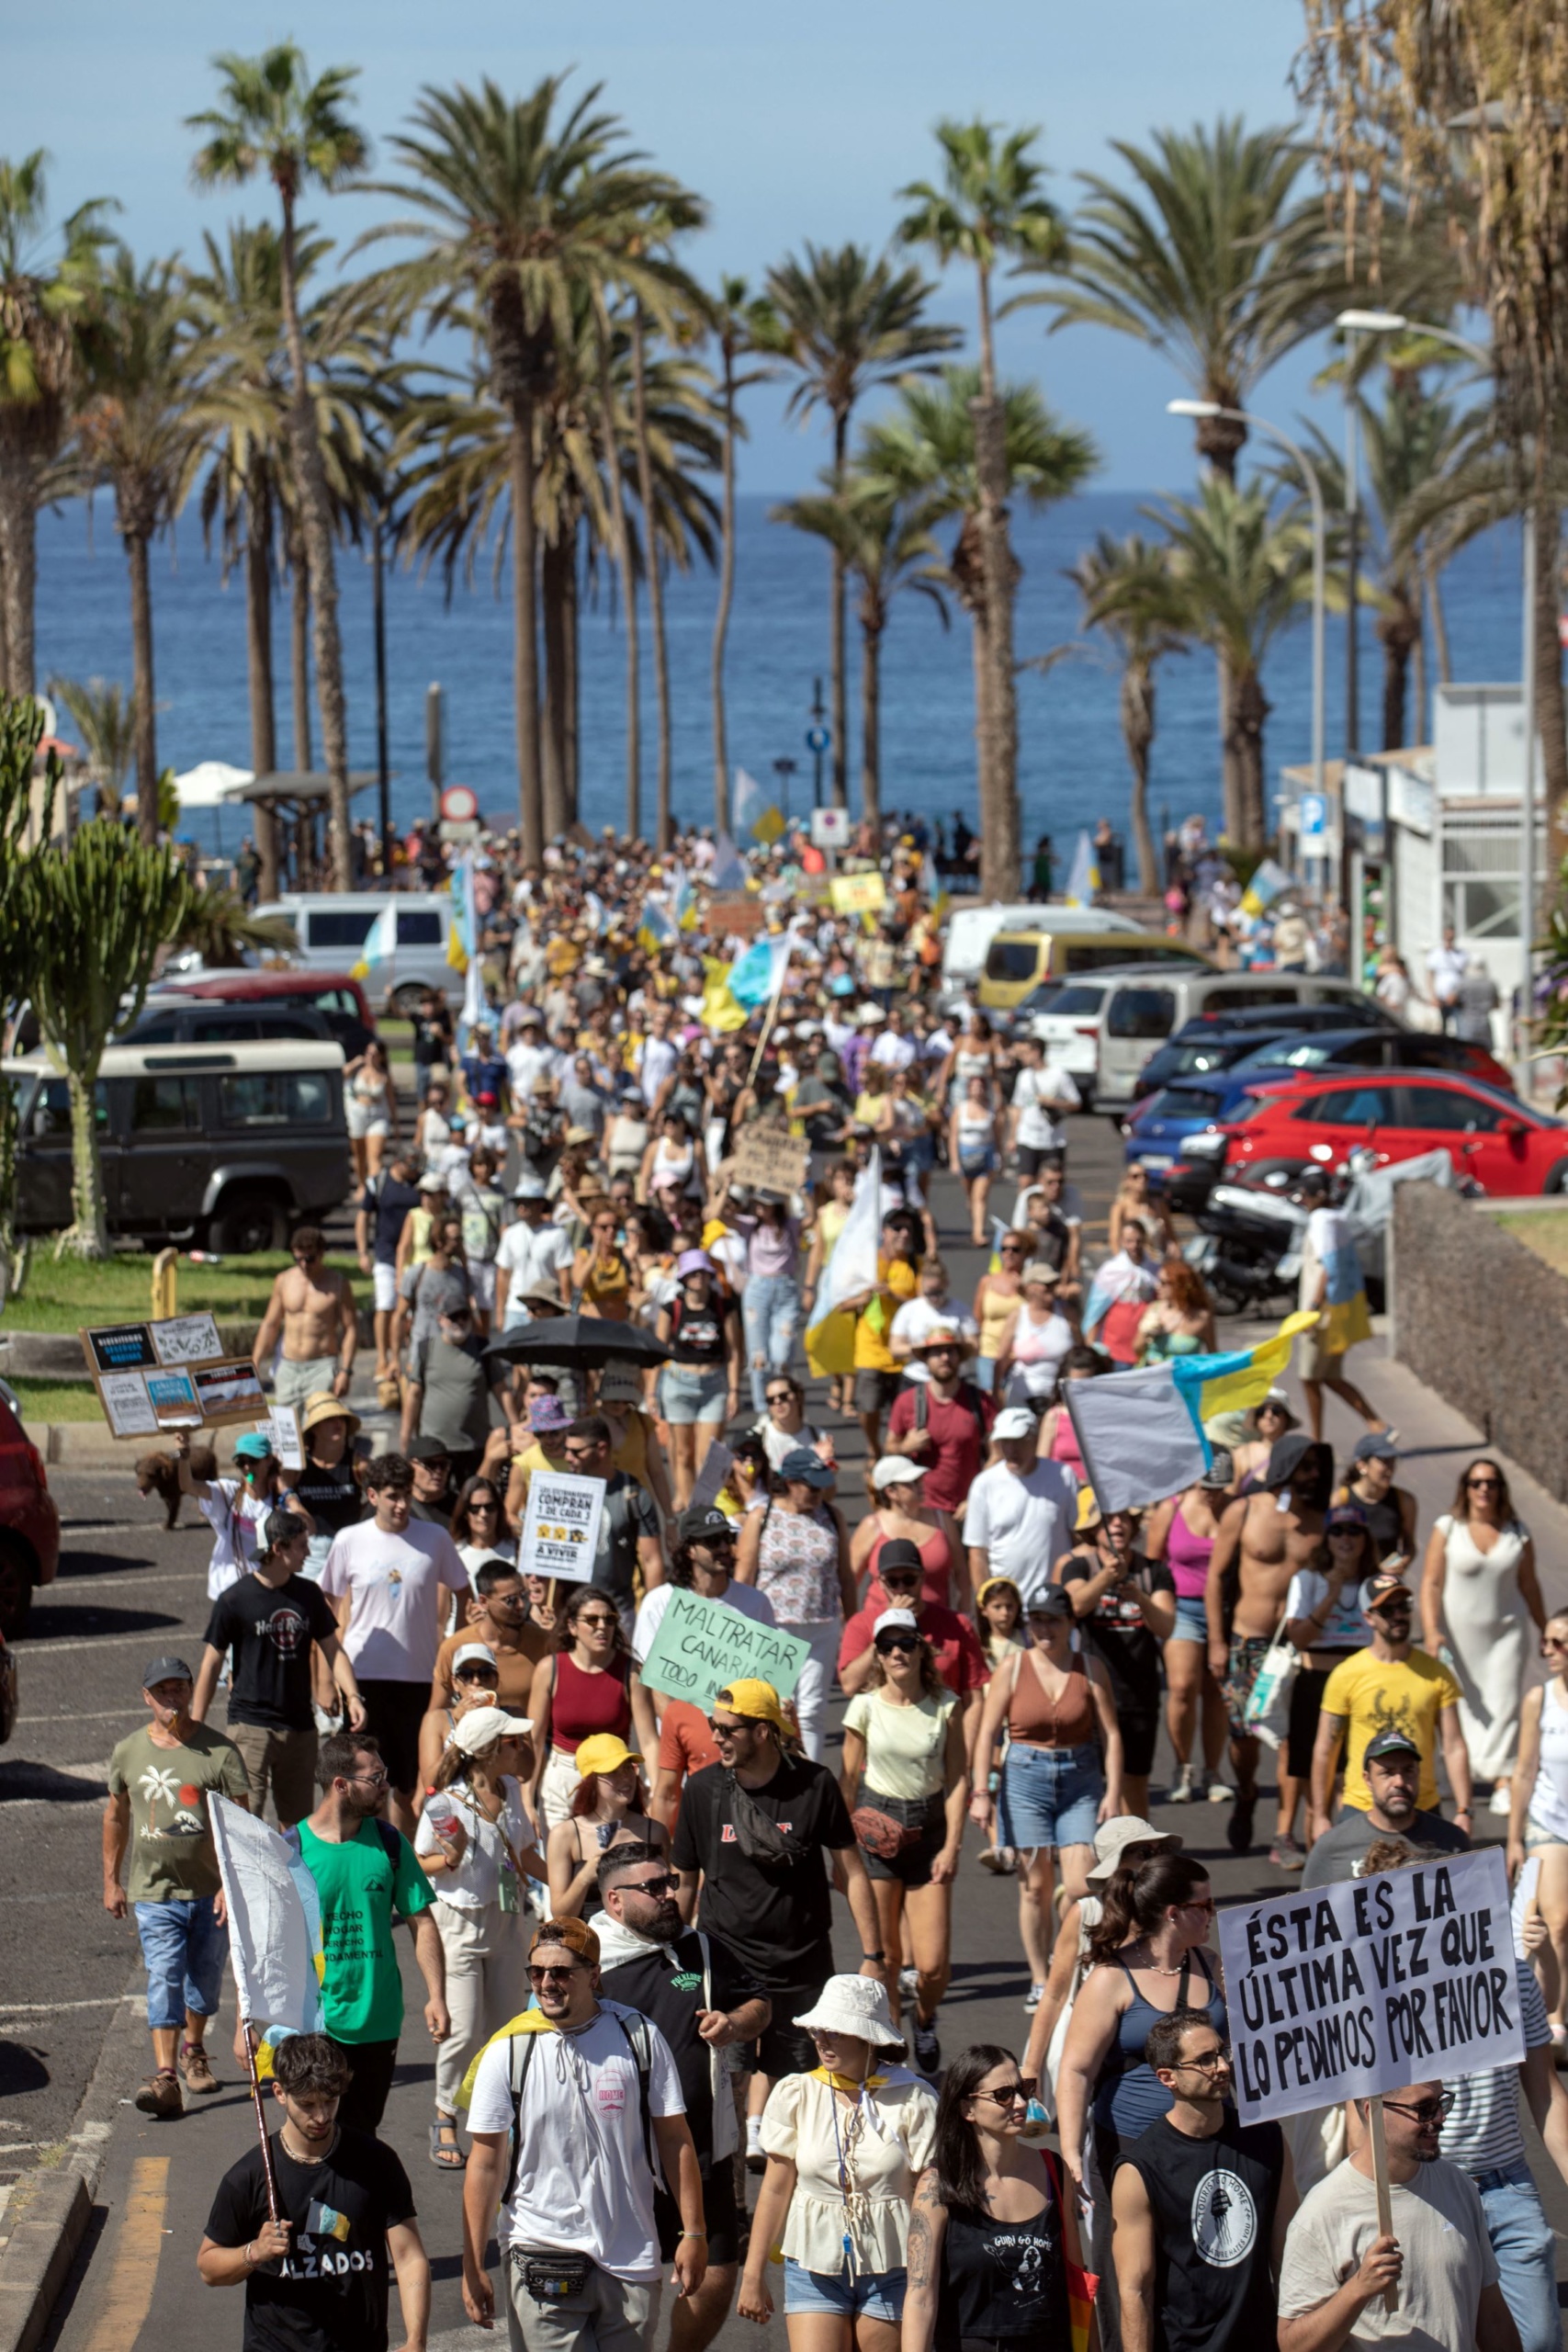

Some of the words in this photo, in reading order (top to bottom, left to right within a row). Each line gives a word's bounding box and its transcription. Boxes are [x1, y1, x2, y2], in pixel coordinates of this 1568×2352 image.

[539, 1494, 592, 1510] COMPRAN
[546, 1507, 556, 1516] DE
[559, 1509, 581, 1519] CADA
[537, 1545, 544, 1554] A
[547, 1547, 578, 1558] VIVIR
[254, 1617, 283, 1635] Hard
[672, 1598, 798, 1670] MALTRATAR
[681, 1634, 774, 1684] CANARIAS
[660, 1657, 698, 1689] TODO
[326, 1910, 363, 1921] TECHO
[1246, 1899, 1342, 1967] ÉSTA
[1353, 1881, 1394, 1938] ES
[1412, 1866, 1457, 1923] LA
[325, 1924, 363, 1935] HOGAR
[671, 1973, 702, 1987] FOLKLORE
[1239, 1948, 1365, 2031] ÚLTIMA
[1370, 1927, 1429, 1990] VEZ
[1440, 1907, 1495, 1967] QUE
[1238, 2039, 1270, 2103] LO
[1274, 2006, 1376, 2090] PEDIMOS
[1385, 1988, 1434, 2063] POR
[1433, 1967, 1514, 2052] FAVOR
[599, 2089, 625, 2101] HOME
[1197, 2178, 1215, 2218] TOURIST
[1216, 2175, 1227, 2185] GO
[1229, 2178, 1248, 2205] HOME
[994, 2234, 1016, 2247] GUIRI
[1018, 2235, 1032, 2245] GO
[1033, 2236, 1053, 2252] HOME
[1205, 2245, 1229, 2258] NATURE
[1229, 2239, 1247, 2256] HATES
[1242, 2222, 1252, 2239] YOU
[278, 2249, 374, 2280] ALZADOS
